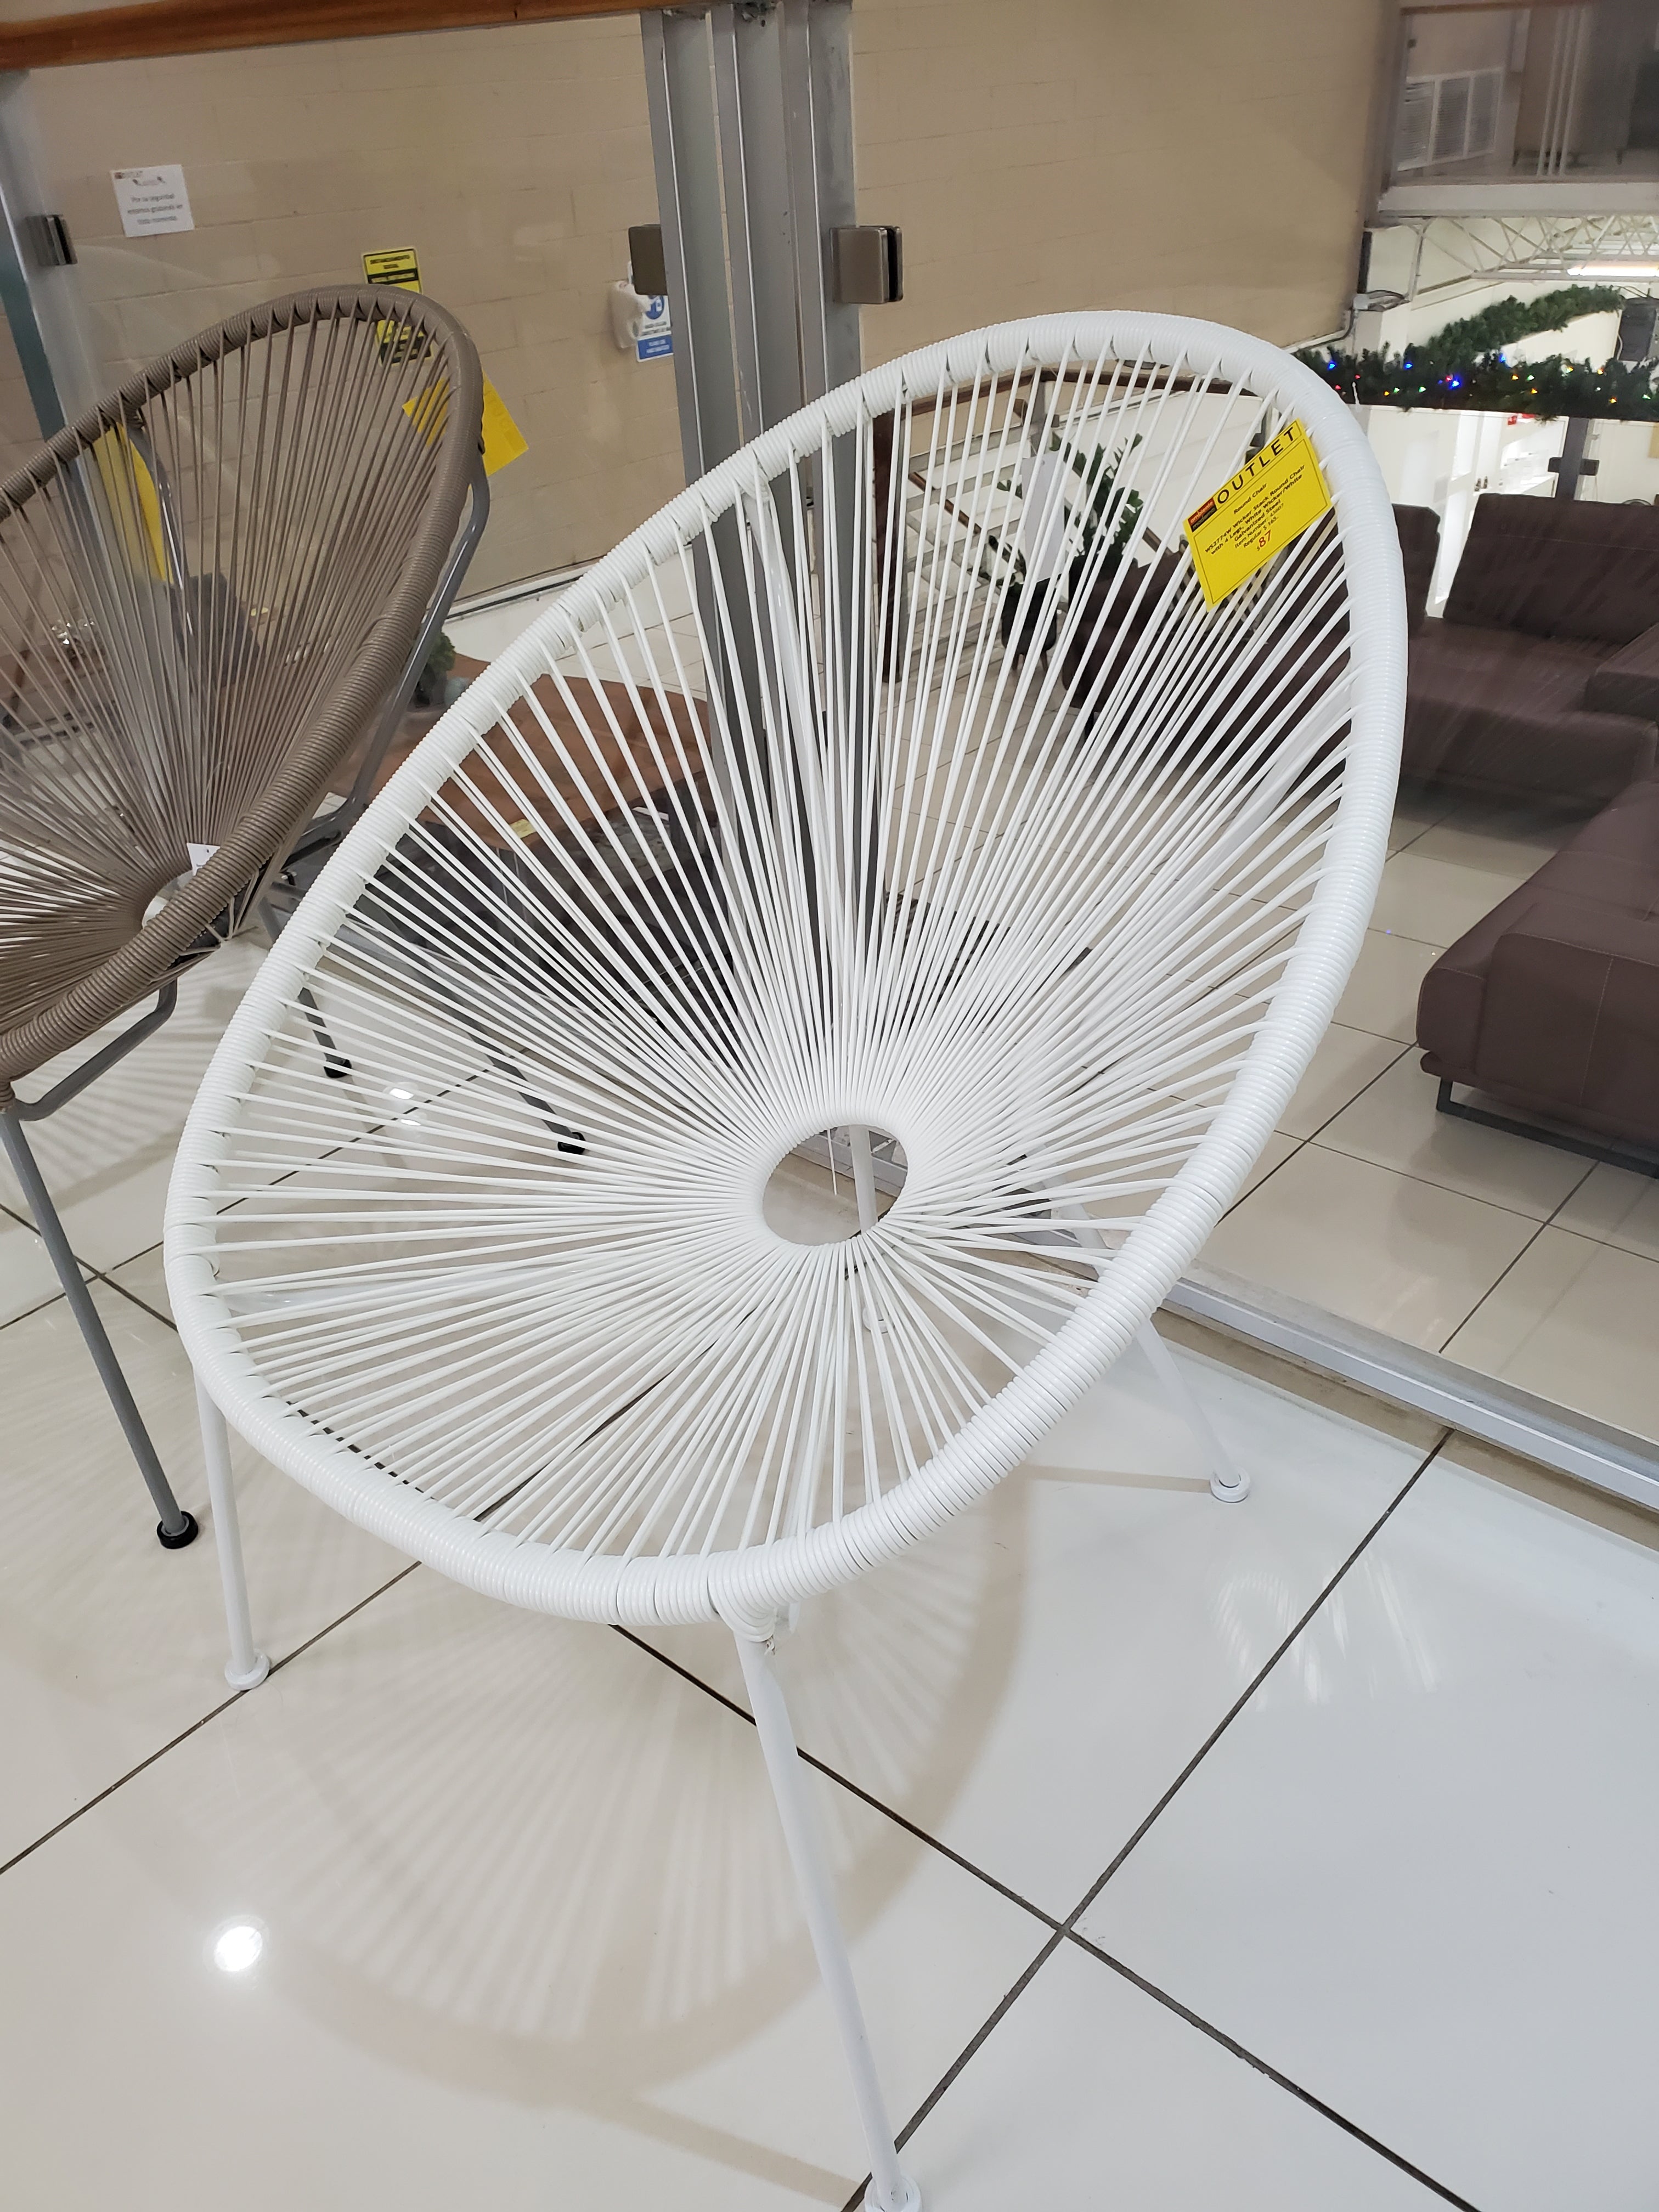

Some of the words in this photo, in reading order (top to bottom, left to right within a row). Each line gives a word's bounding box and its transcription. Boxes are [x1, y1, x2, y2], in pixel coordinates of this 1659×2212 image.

[1217, 426, 1294, 504] OUTLET
[1211, 543, 1224, 555] with
[1229, 526, 1244, 539] Legs,
[1245, 509, 1262, 524] White
[1262, 474, 1302, 509] Wicker/White
[1232, 510, 1252, 528] Wicker
[1252, 496, 1269, 511] Stack
[1269, 478, 1289, 496] Round
[1289, 465, 1305, 479] Chair
[1233, 496, 1251, 515] Round
[1252, 482, 1267, 498] Chair
[1234, 512, 1265, 541] Galvanized
[1265, 498, 1282, 514] Steel
[1243, 530, 1262, 548] Regular
[1234, 537, 1247, 549] Item
